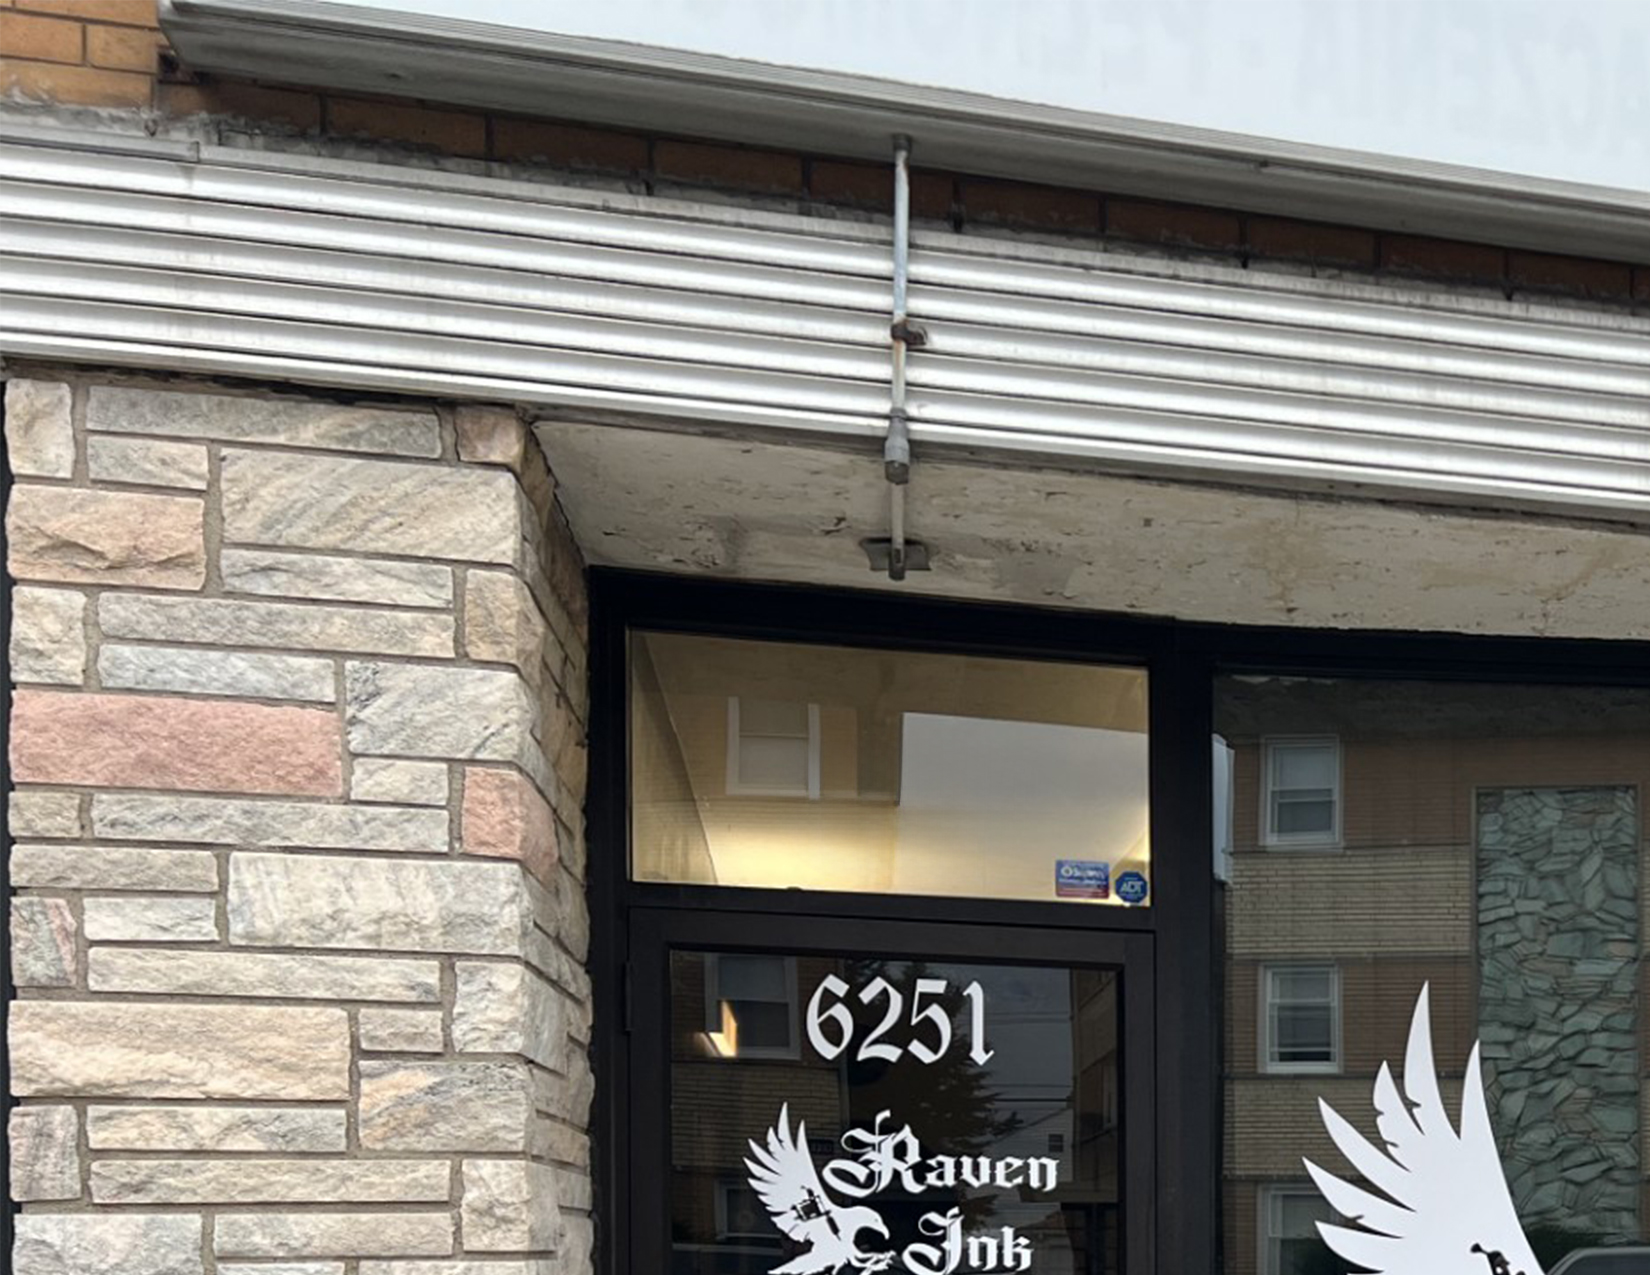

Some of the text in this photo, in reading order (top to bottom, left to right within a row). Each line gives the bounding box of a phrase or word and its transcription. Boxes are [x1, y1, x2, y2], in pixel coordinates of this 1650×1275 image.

[1120, 881, 1144, 893] ADT
[806, 974, 995, 1066] 6251
[823, 1110, 1060, 1199] Raven
